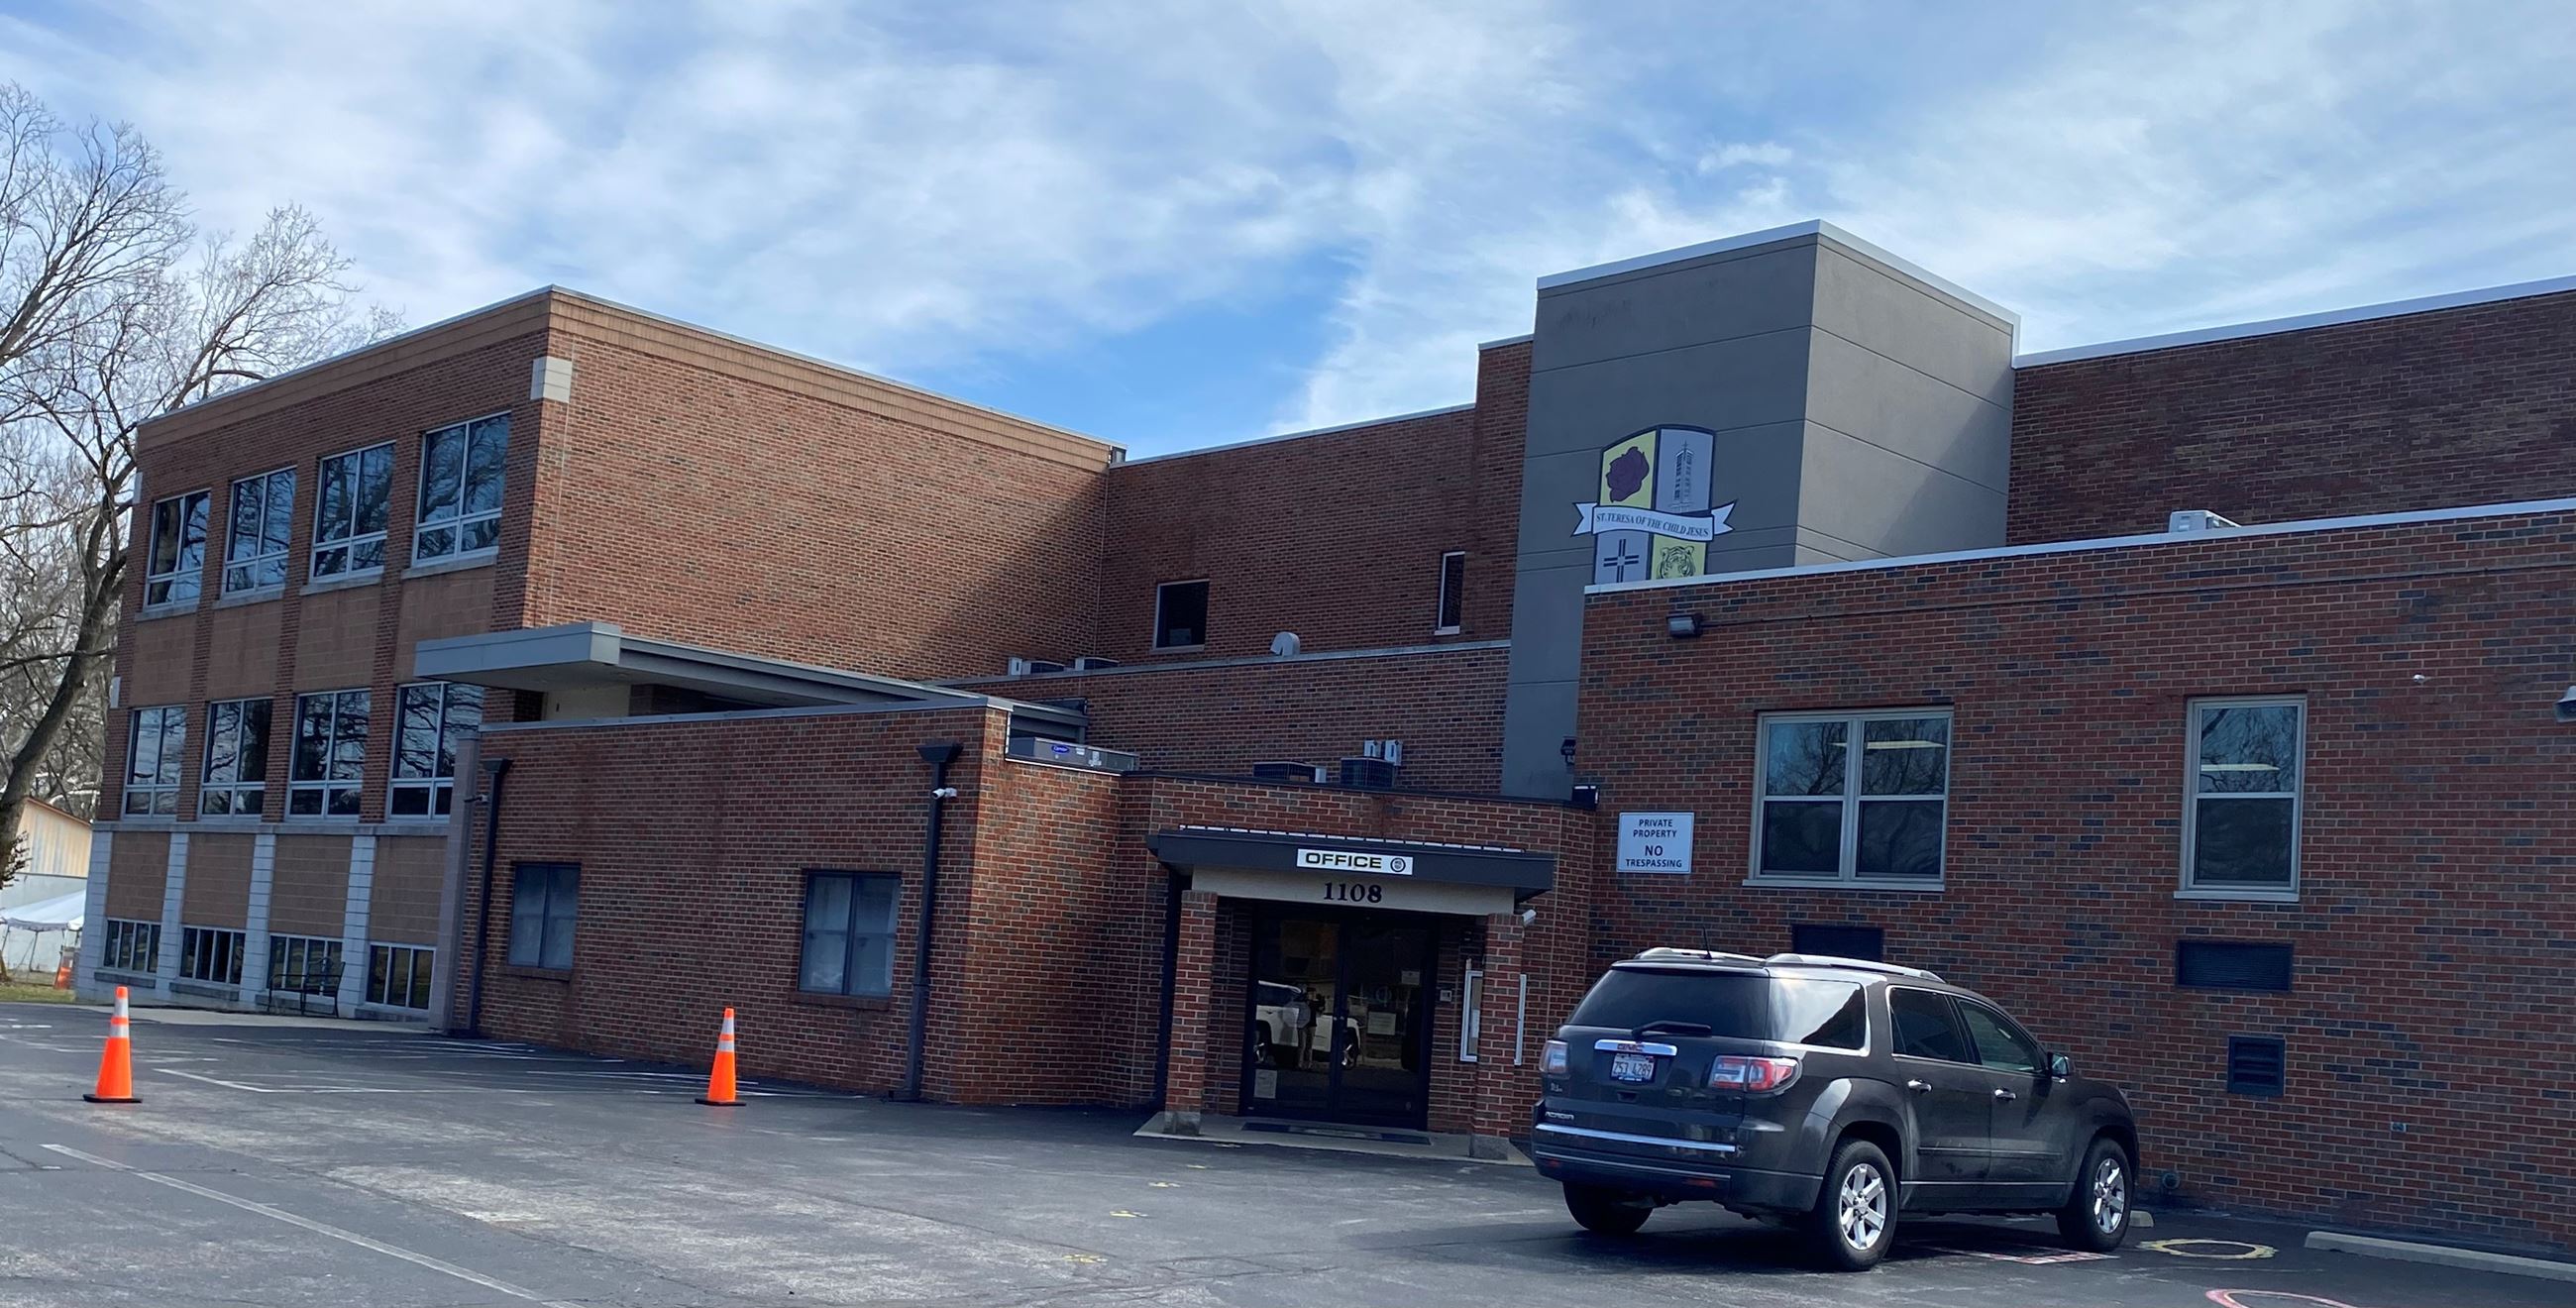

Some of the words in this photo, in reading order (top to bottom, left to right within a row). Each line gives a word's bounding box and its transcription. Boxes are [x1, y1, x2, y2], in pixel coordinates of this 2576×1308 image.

[1607, 513, 1635, 524] TERESA
[1636, 515, 1647, 525] OF
[1647, 518, 1663, 529] THE
[1663, 521, 1686, 535] CHILD
[1686, 527, 1709, 537] JESUS
[1639, 818, 1673, 827] PRIVATE
[1633, 829, 1677, 838] PROPERTY
[1645, 844, 1664, 857] NO
[1305, 852, 1382, 869] OFFICE
[1625, 858, 1682, 868] TRESPASSING
[1324, 882, 1382, 904] 1108
